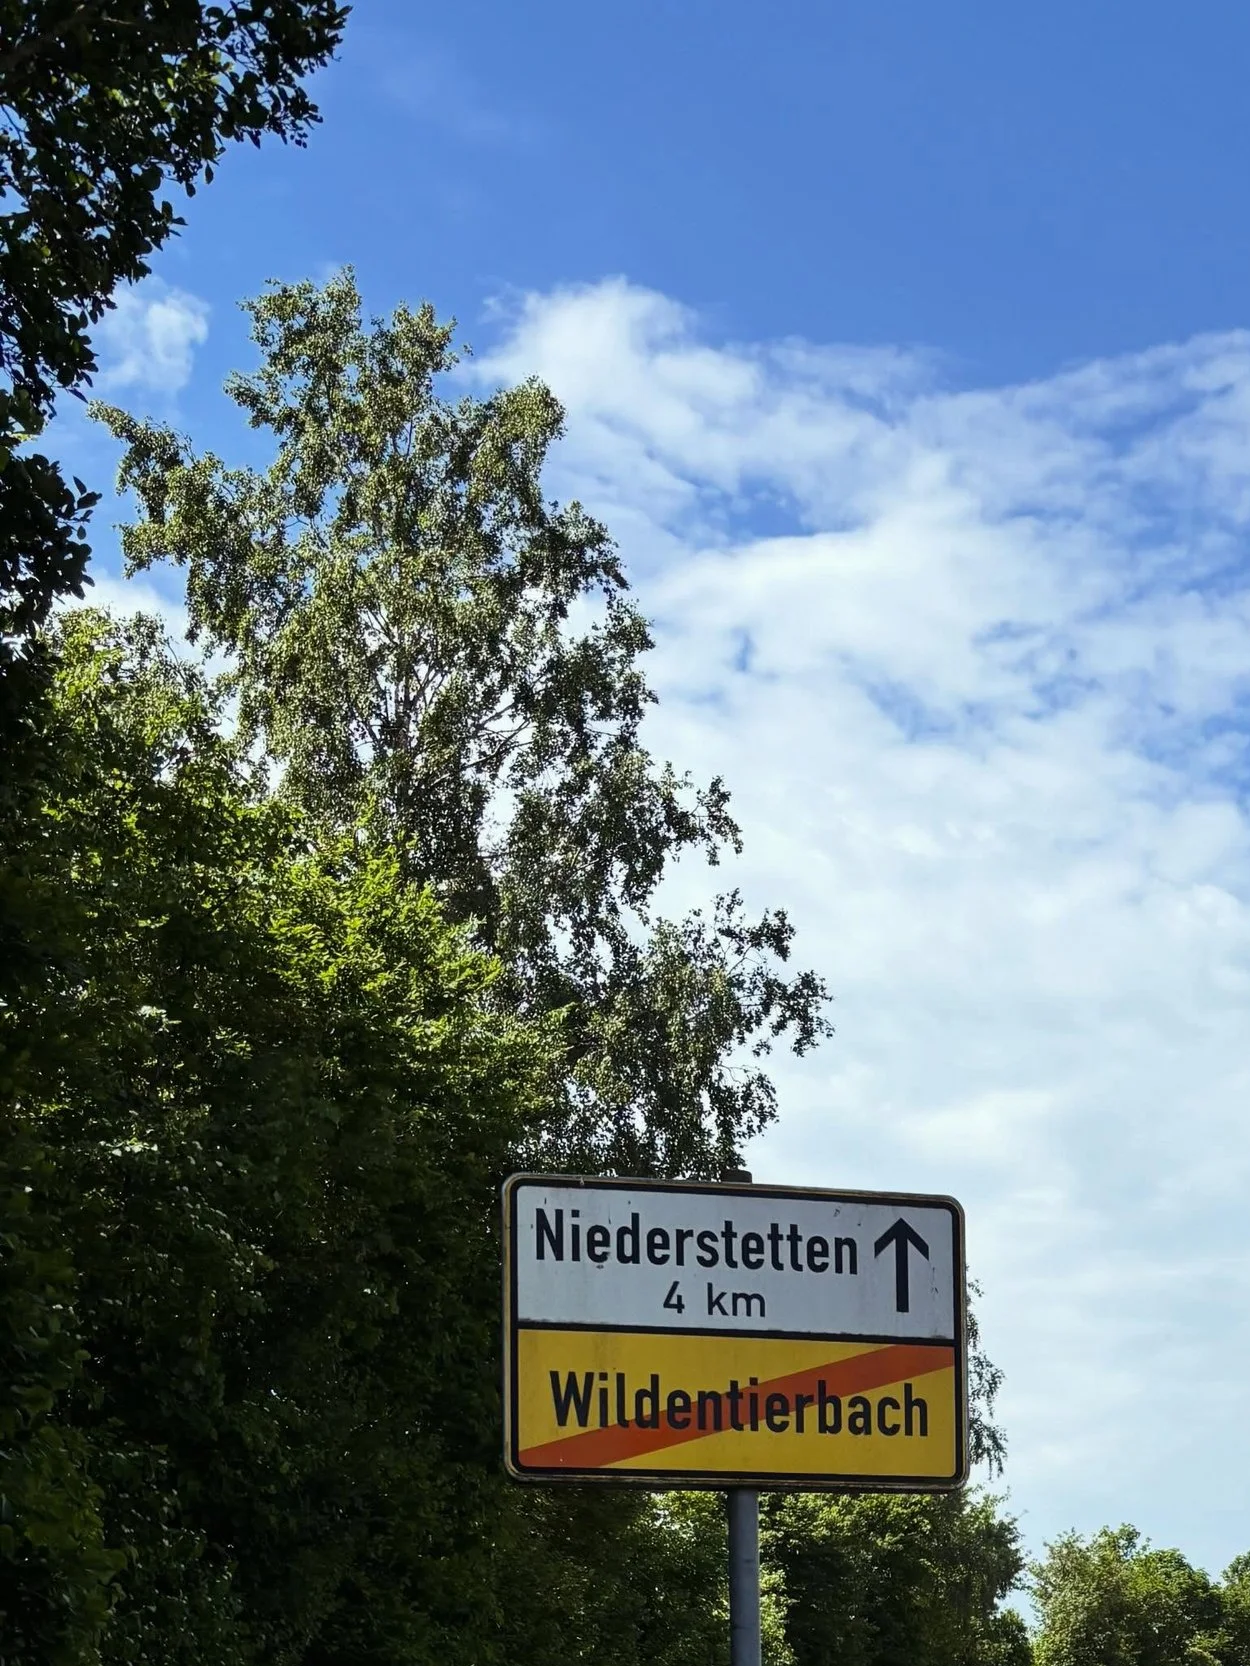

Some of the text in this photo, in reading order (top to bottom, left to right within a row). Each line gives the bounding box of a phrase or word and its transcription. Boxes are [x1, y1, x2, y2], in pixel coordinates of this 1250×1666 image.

[535, 1207, 858, 1275] Niederstetten
[662, 1280, 766, 1318] 4 km
[549, 1370, 929, 1436] Wildentierbach
